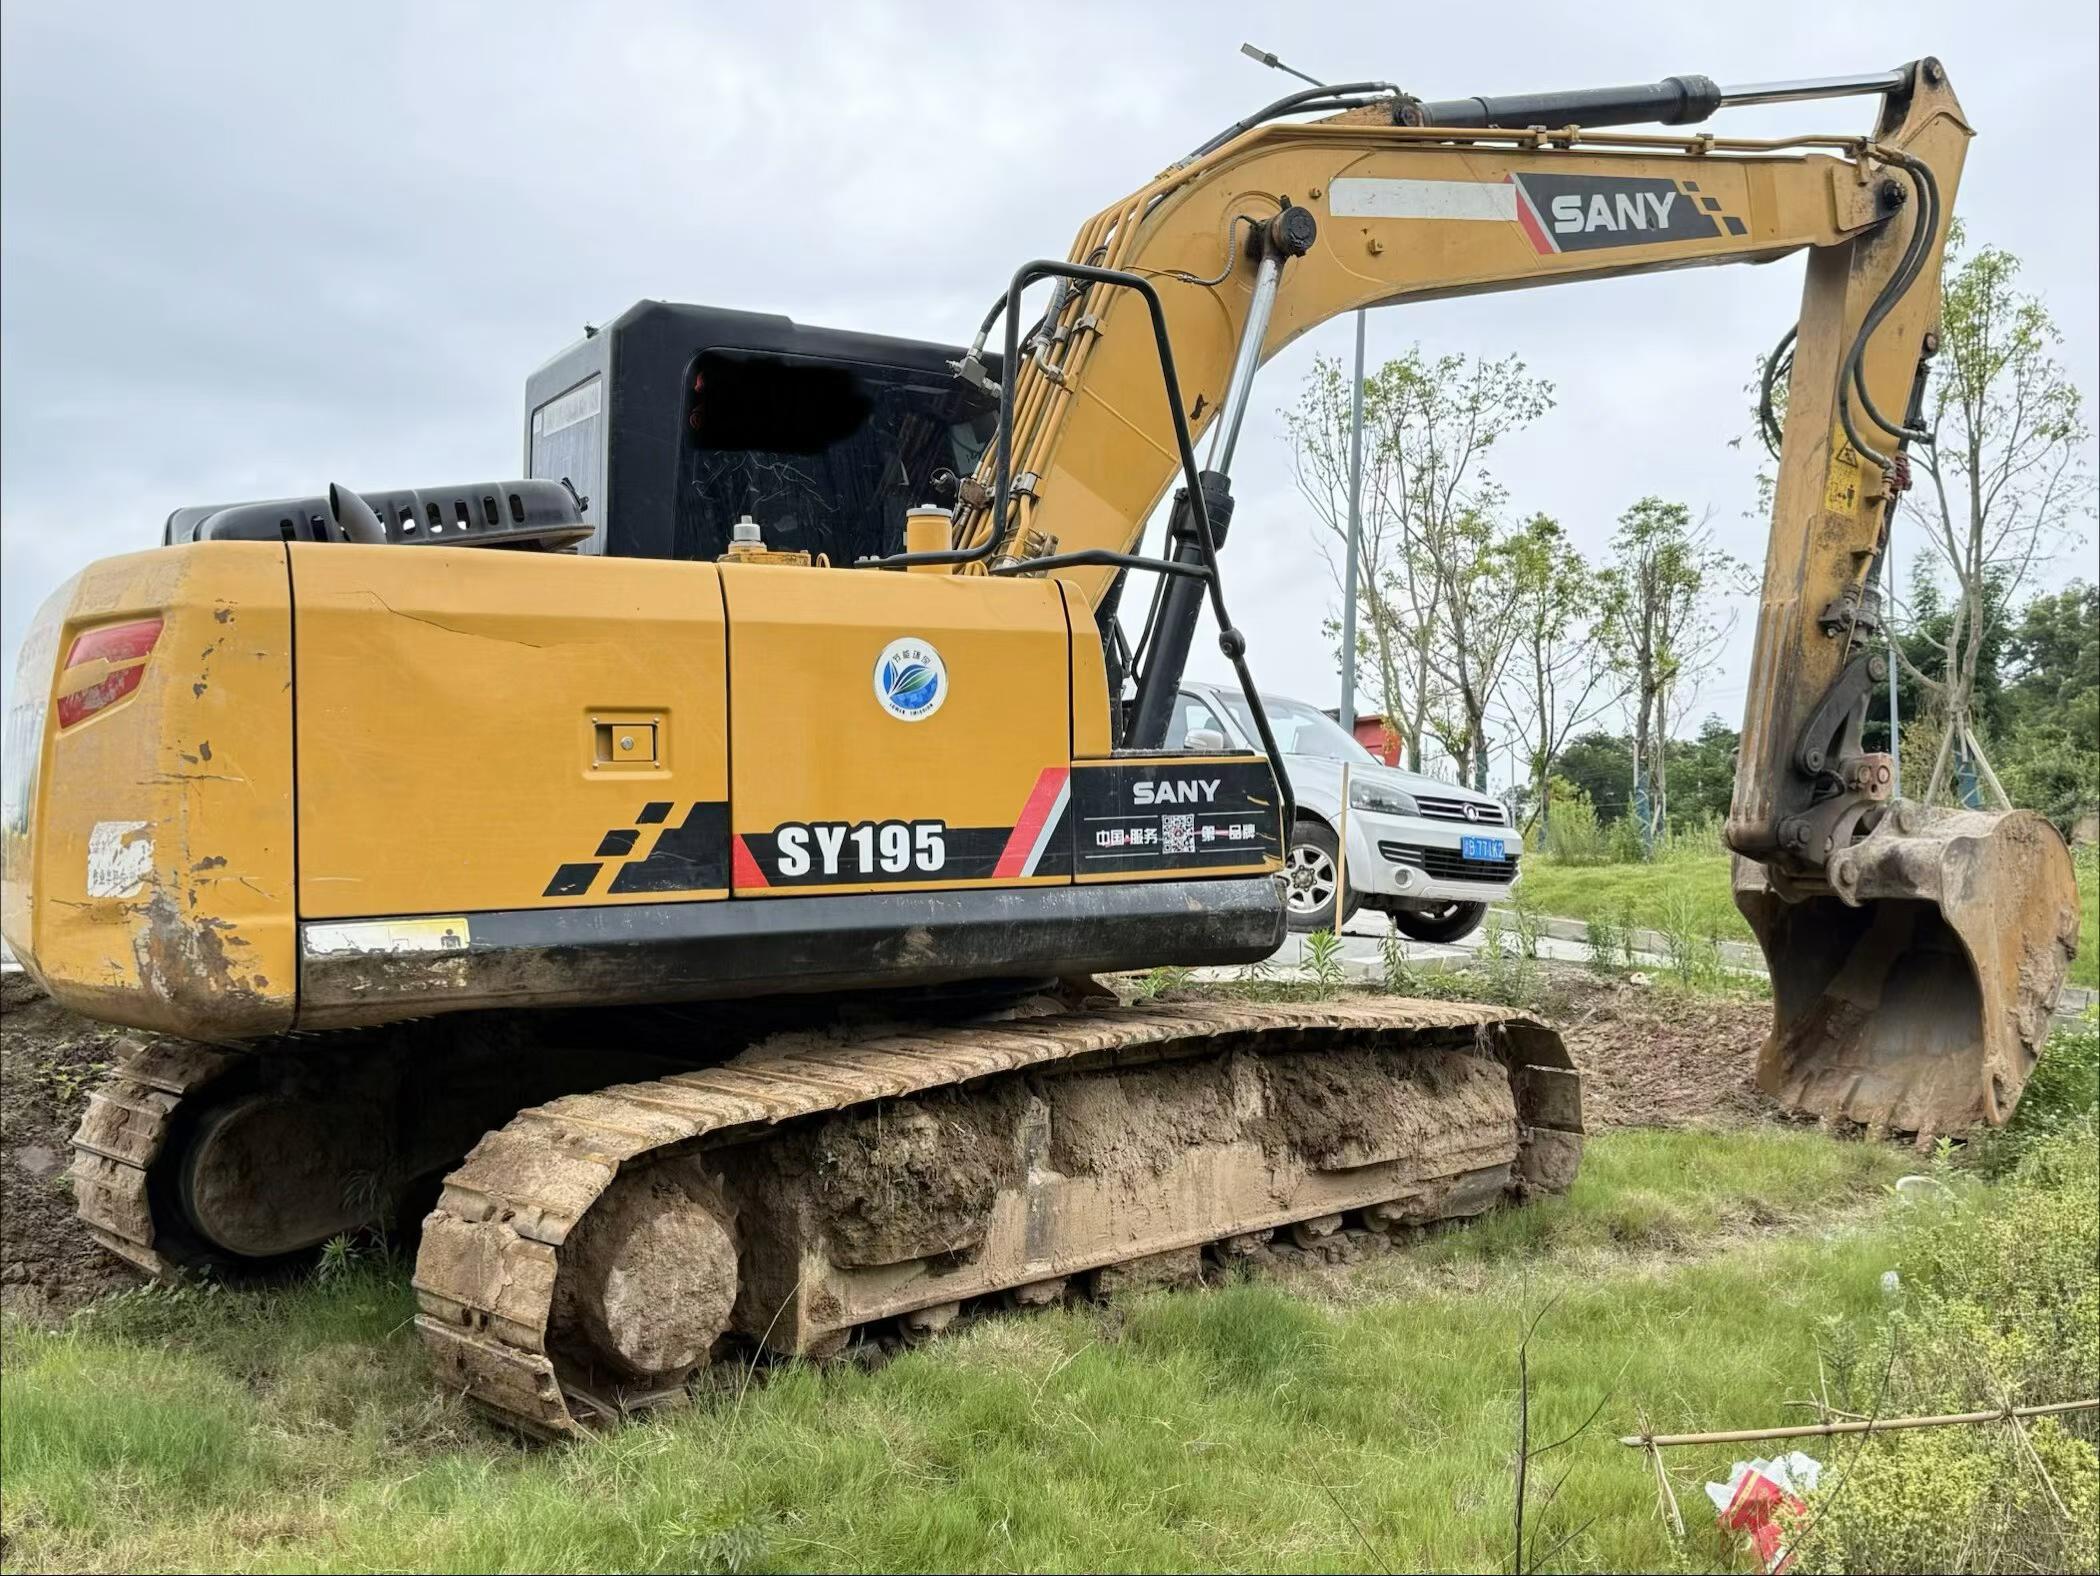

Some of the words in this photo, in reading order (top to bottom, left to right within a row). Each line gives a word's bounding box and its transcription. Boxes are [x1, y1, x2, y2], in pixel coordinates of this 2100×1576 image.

[1551, 191, 1677, 234] SANY
[1132, 779, 1221, 805] SANY
[777, 824, 946, 877] SY195
